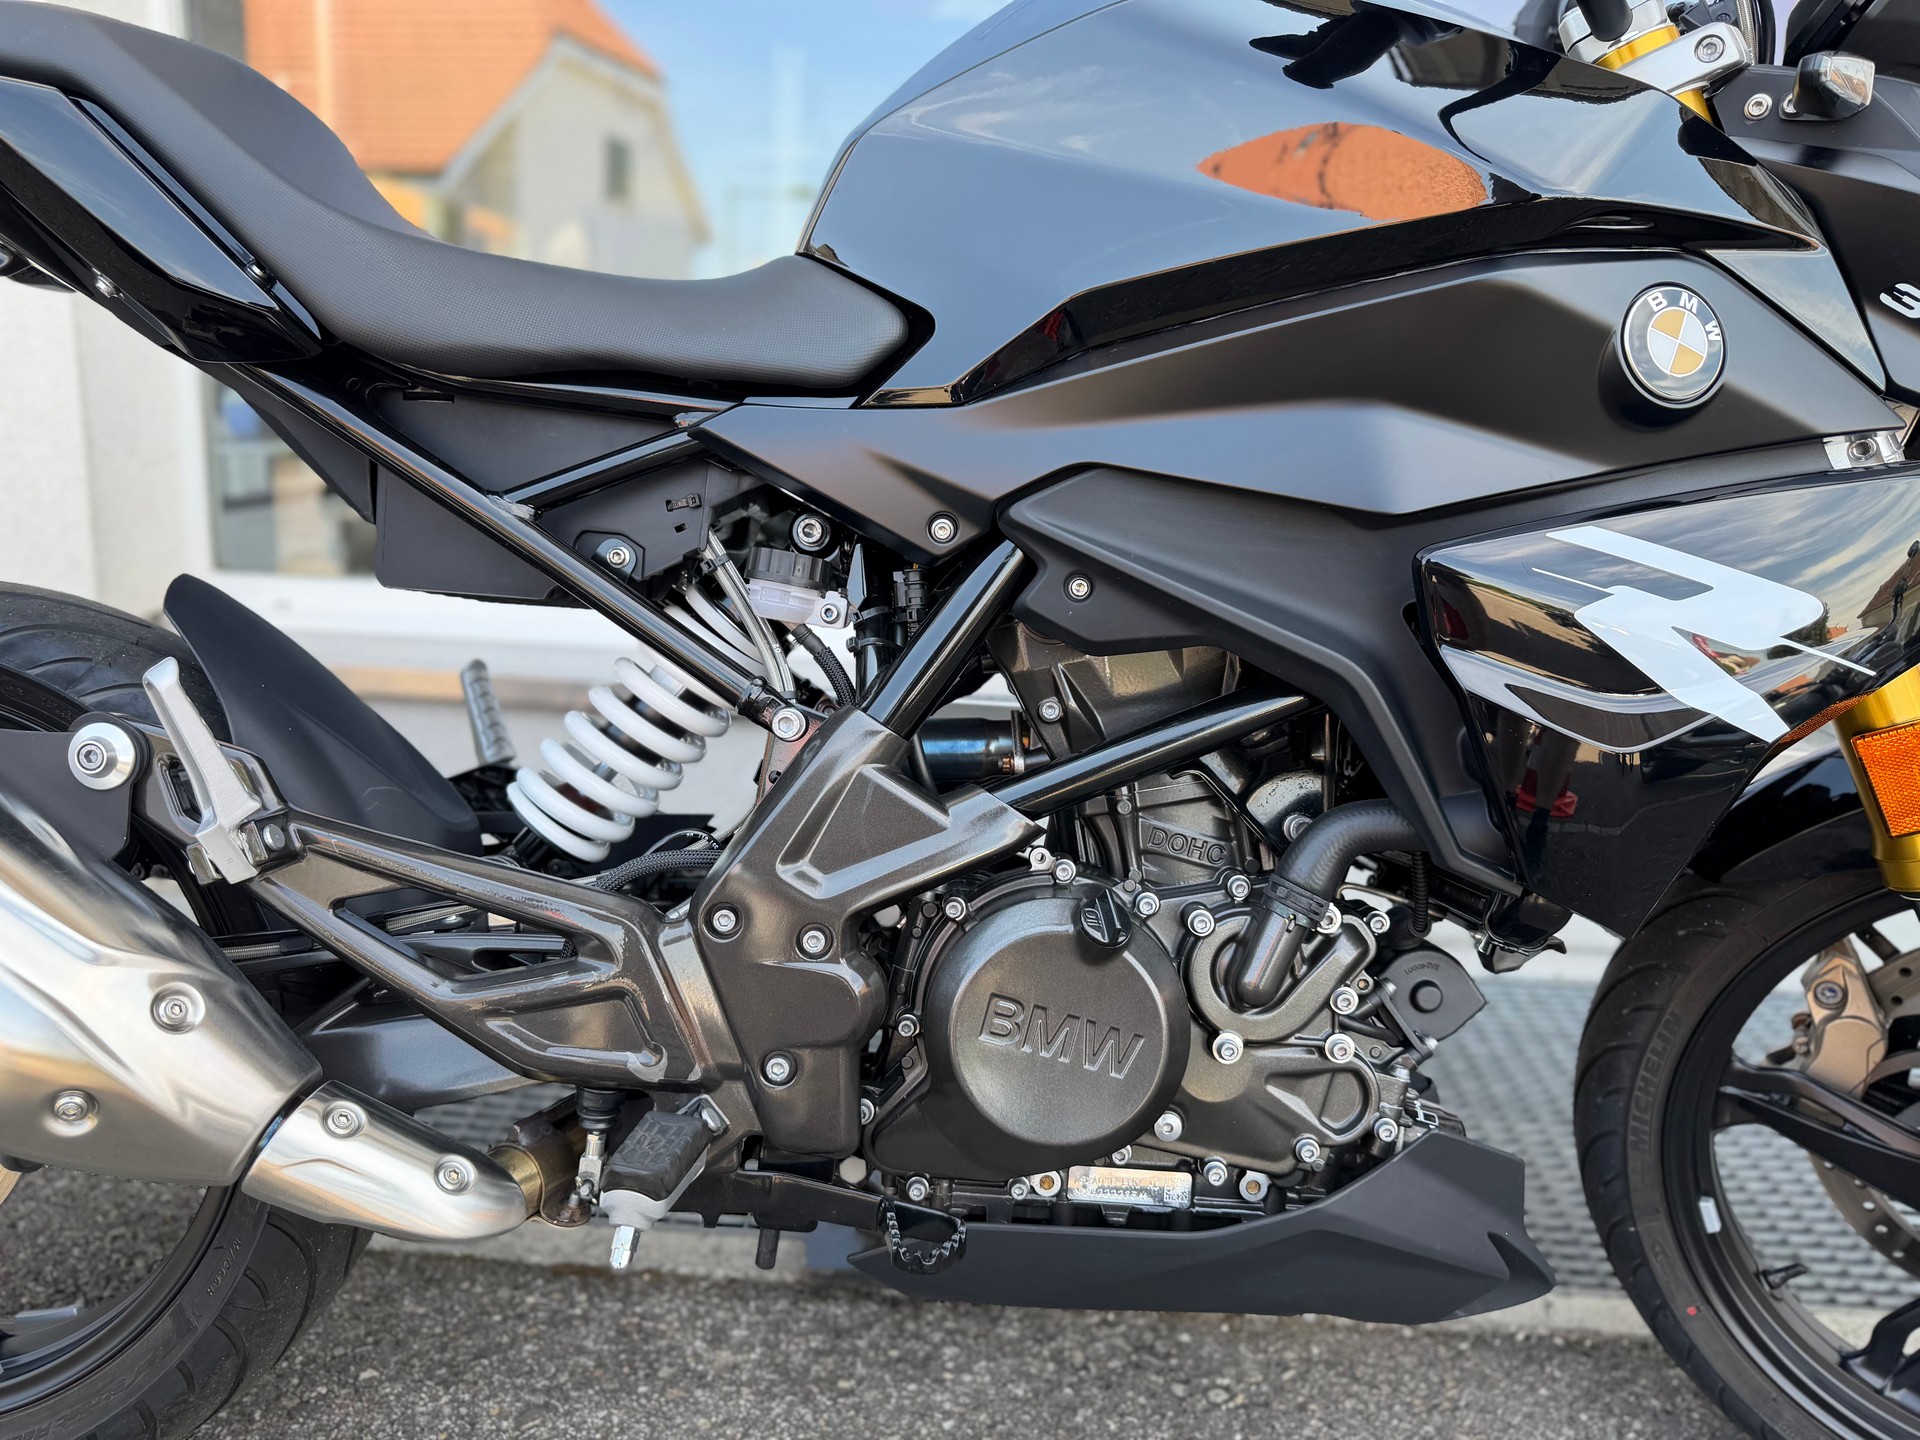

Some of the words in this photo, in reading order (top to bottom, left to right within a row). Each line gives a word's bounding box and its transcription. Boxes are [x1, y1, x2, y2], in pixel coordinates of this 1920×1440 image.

[1647, 291, 1722, 342] BMW
[1147, 827, 1227, 867] DOHC
[978, 992, 1145, 1079] BMW
[1629, 1007, 1685, 1149] MICHELIN
